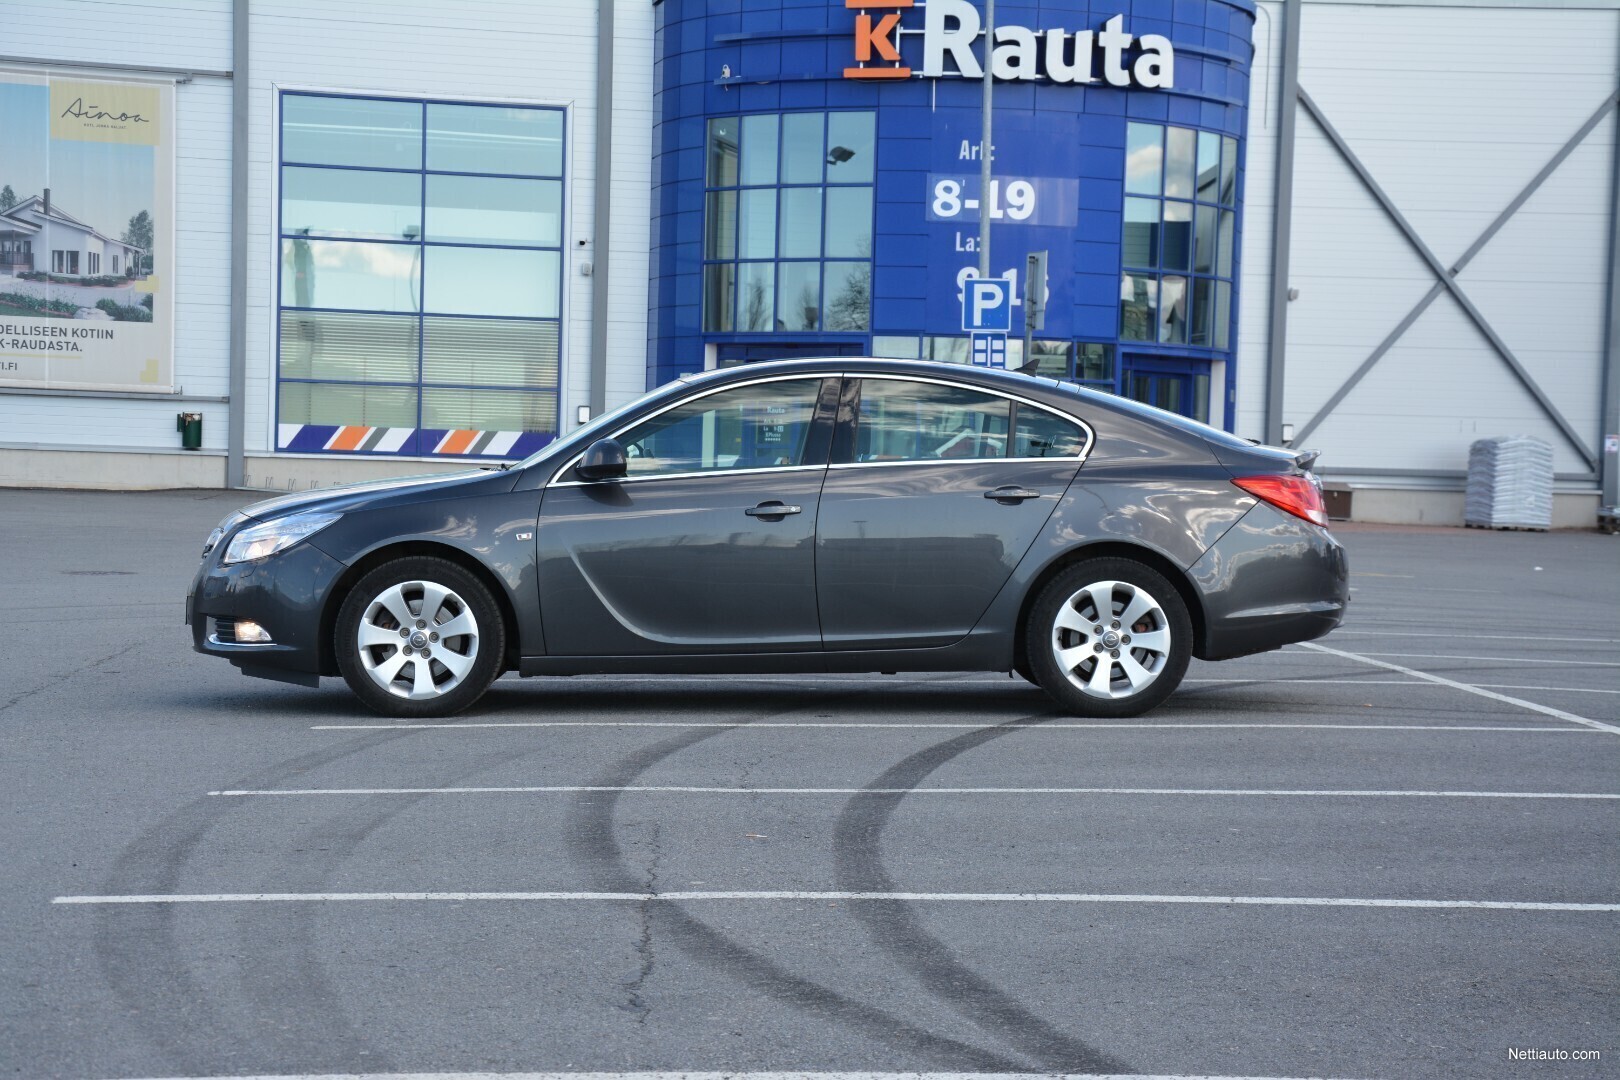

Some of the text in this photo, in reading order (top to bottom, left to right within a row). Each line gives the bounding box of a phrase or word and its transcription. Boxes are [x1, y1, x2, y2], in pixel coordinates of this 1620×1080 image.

[923, 0, 1174, 89] Rauta
[61, 97, 150, 123] Ainoa
[932, 179, 1036, 221] 8-19
[972, 283, 1004, 327] P
[71, 328, 114, 340] KOTIIN
[0, 361, 18, 371] I.FI
